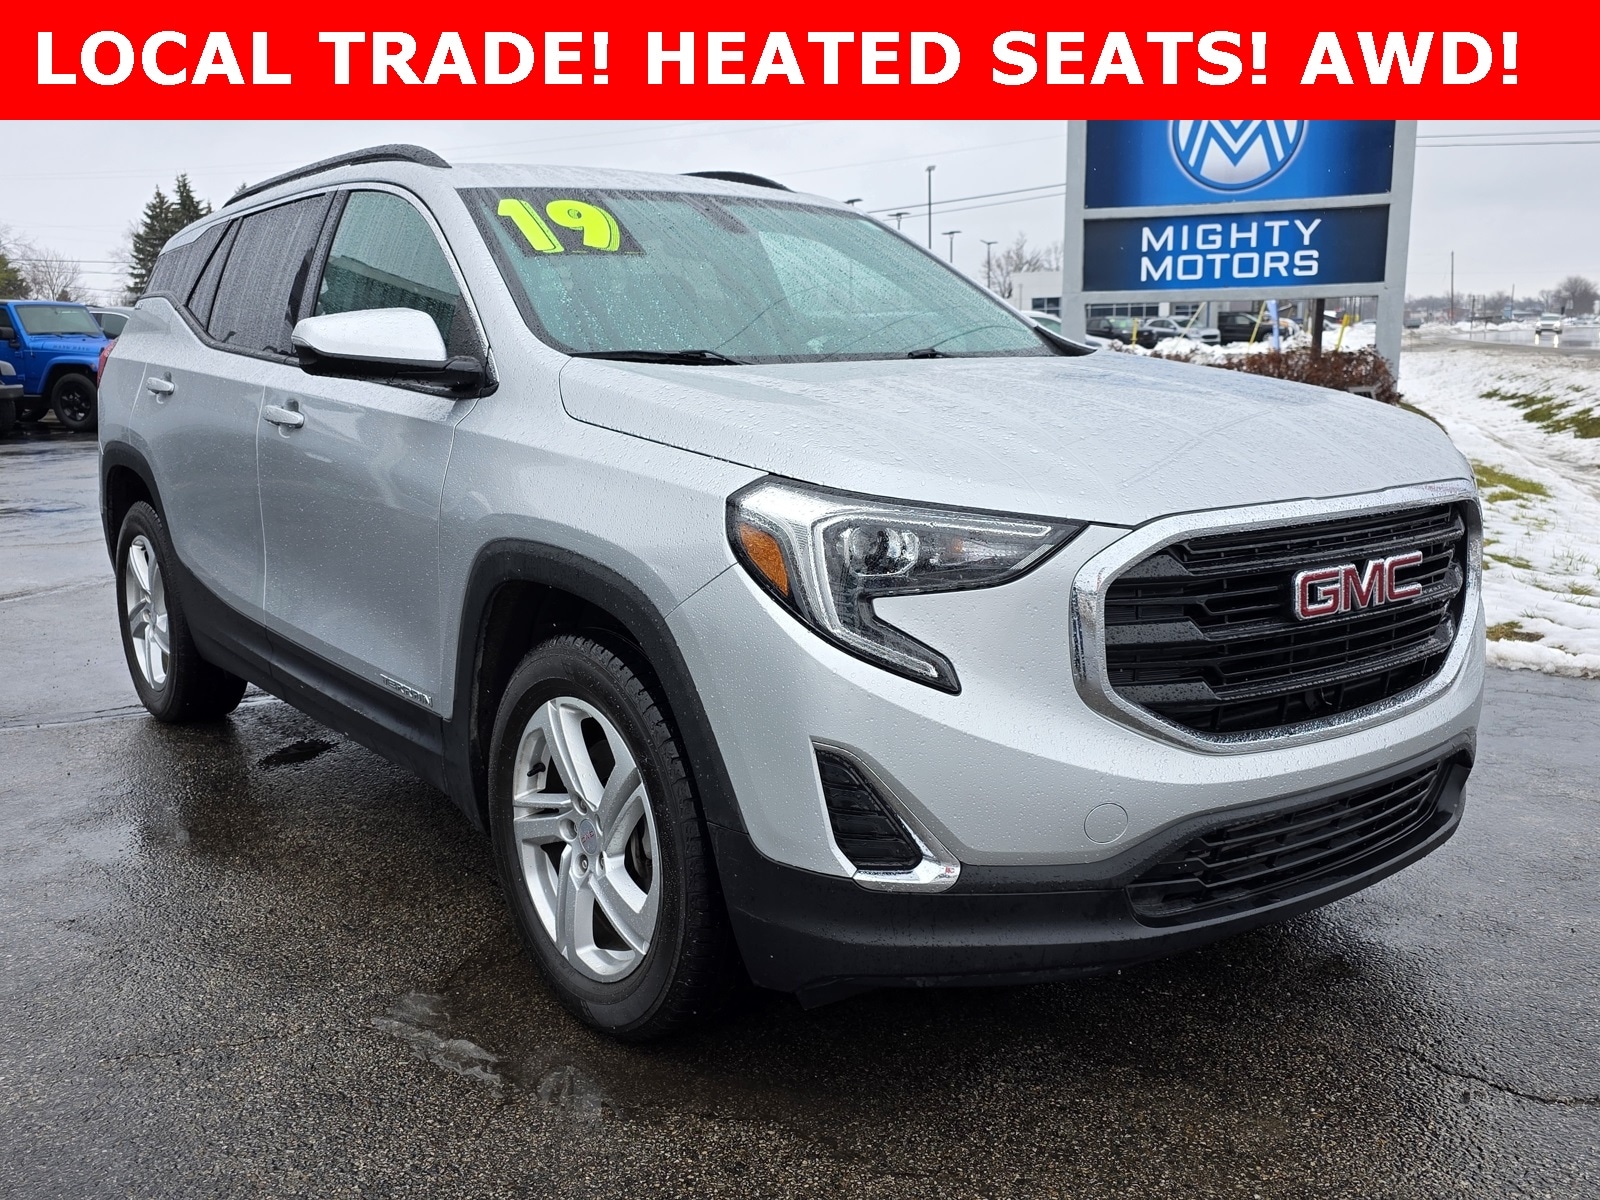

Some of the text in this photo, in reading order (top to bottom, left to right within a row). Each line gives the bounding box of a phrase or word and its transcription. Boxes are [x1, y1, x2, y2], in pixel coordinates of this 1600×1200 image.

[497, 198, 621, 253] 19
[1141, 218, 1322, 253] MIGHTY
[1140, 249, 1320, 282] MOTORS
[1294, 550, 1423, 621] GMC
